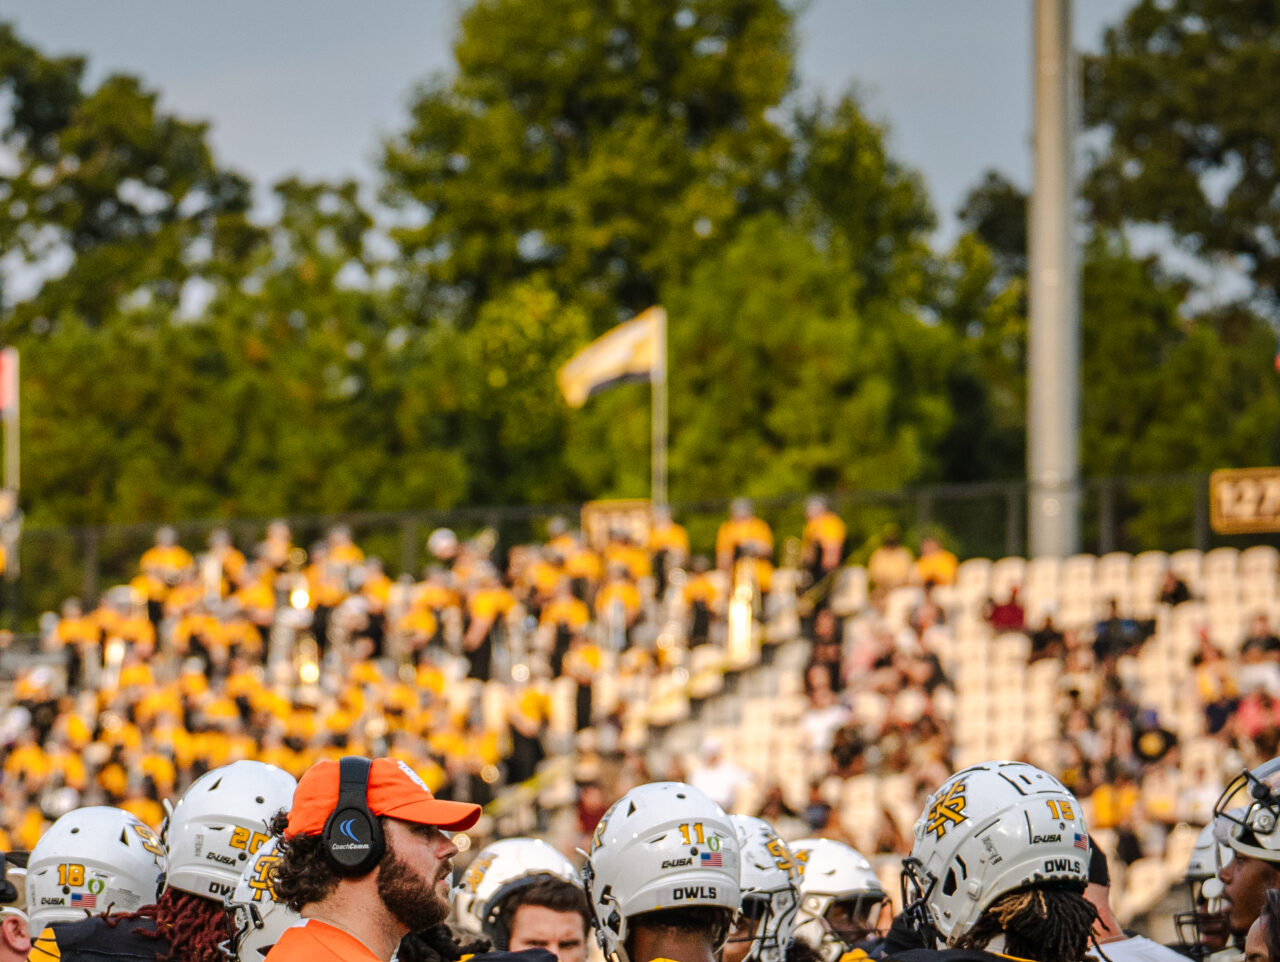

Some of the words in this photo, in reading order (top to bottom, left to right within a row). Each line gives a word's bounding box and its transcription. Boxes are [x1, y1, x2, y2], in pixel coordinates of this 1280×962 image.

[1046, 799, 1075, 821] 15
[679, 822, 705, 846] 11
[331, 842, 370, 851] CoachComm
[57, 863, 85, 887] 18
[1044, 858, 1082, 874] OWLS
[673, 885, 717, 900] OWLS
